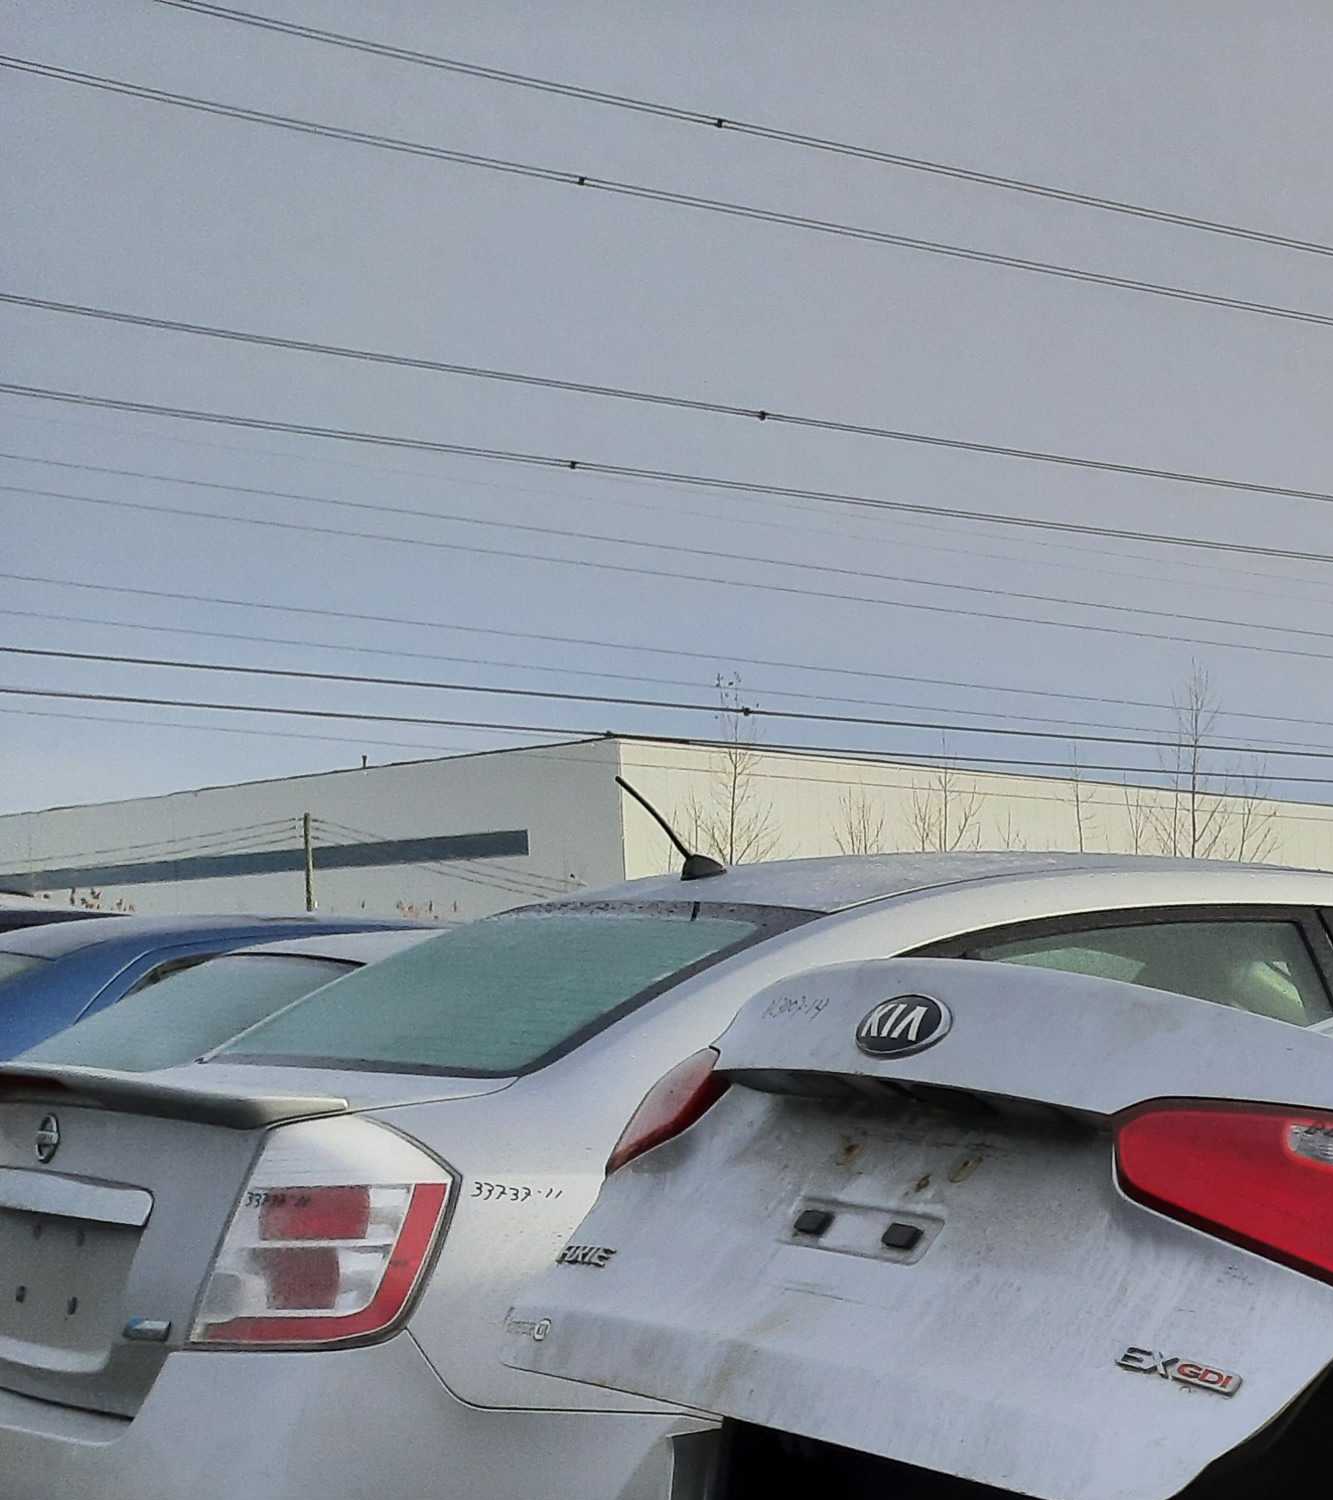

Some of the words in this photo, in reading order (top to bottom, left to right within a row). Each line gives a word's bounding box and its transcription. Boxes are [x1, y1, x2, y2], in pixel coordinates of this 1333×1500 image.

[860, 1003, 929, 1042] KIA
[1114, 1345, 1180, 1381] EX
[1176, 1362, 1234, 1389] GDI
